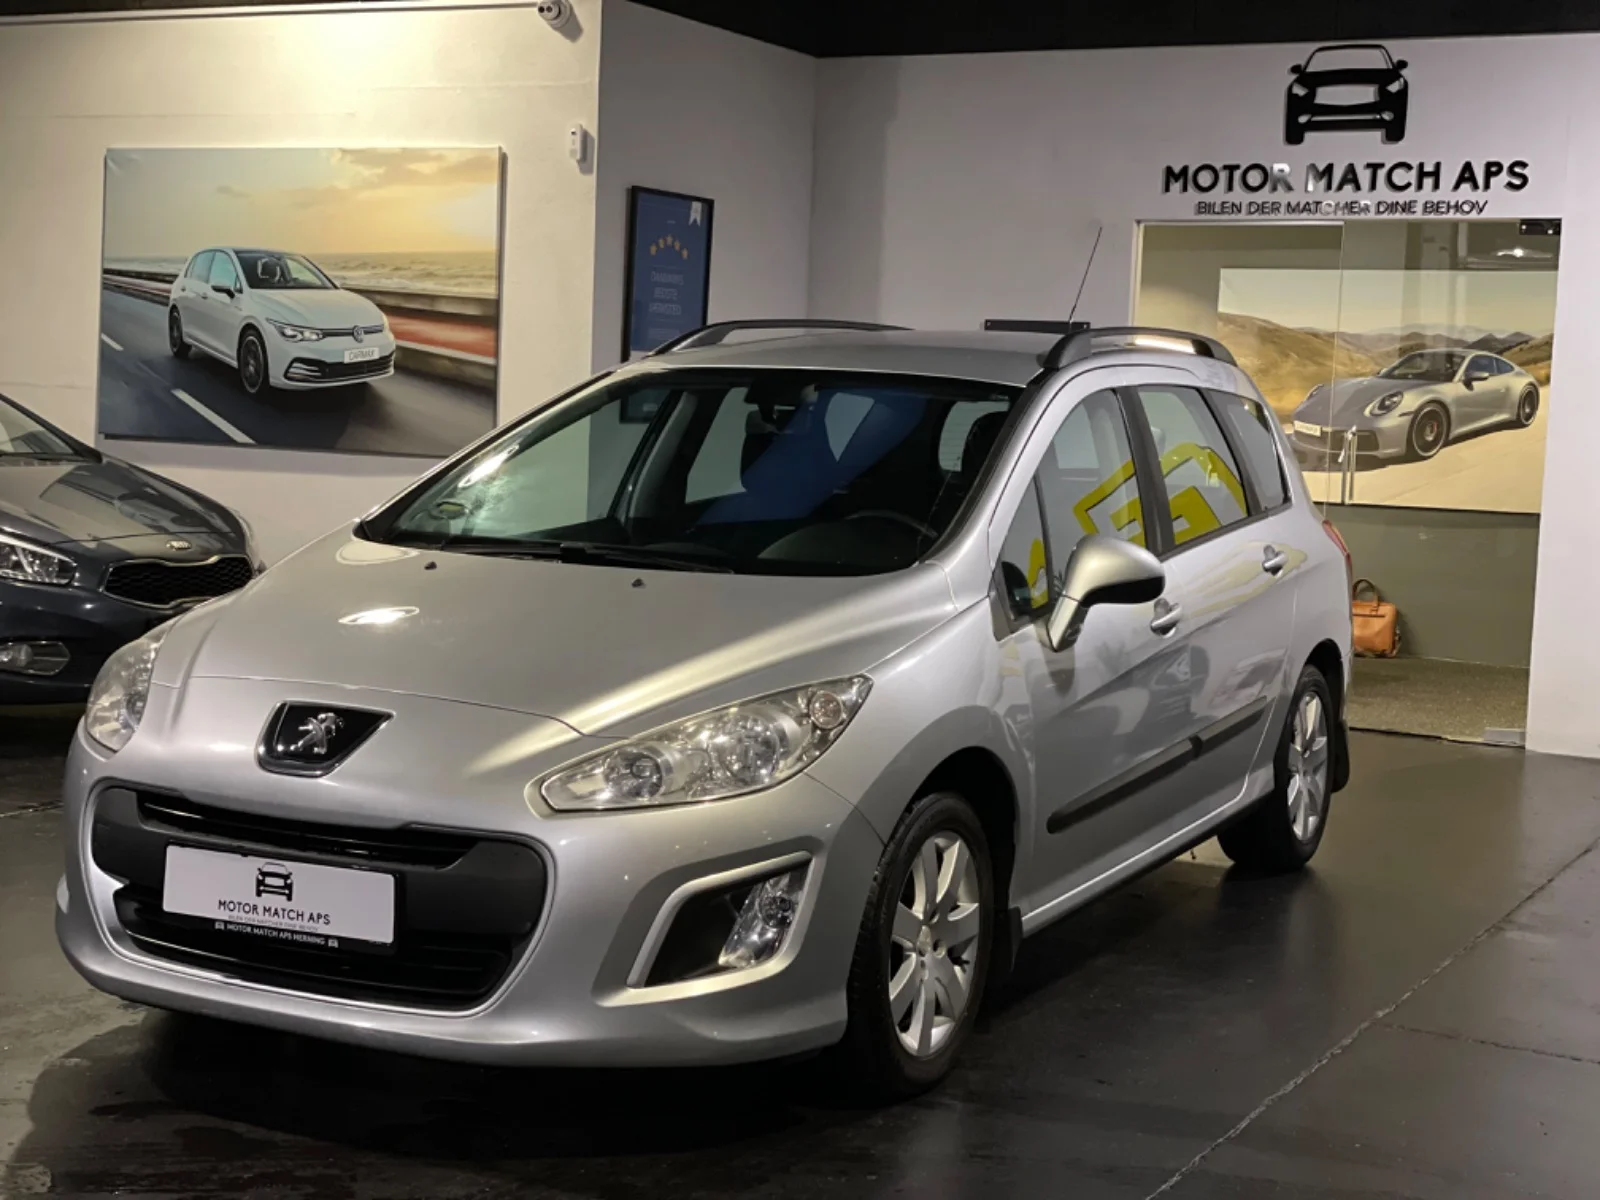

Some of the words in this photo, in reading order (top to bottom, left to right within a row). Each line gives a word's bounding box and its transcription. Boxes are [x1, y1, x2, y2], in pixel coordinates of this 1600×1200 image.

[1163, 163, 1294, 193] MOTOR
[1304, 162, 1442, 193] MATCH
[1451, 160, 1529, 192] APS
[1195, 201, 1242, 216] BILEN
[1246, 201, 1282, 216] DER
[1285, 200, 1371, 216] MATCHER
[1375, 200, 1418, 216] DINE
[1422, 199, 1488, 216] BEHOV
[218, 899, 259, 916] MOTOR
[263, 905, 304, 922] MATCH
[307, 911, 331, 926] APS
[227, 922, 252, 933] MOTOR
[253, 927, 278, 938] MATCH
[279, 931, 292, 940] APS
